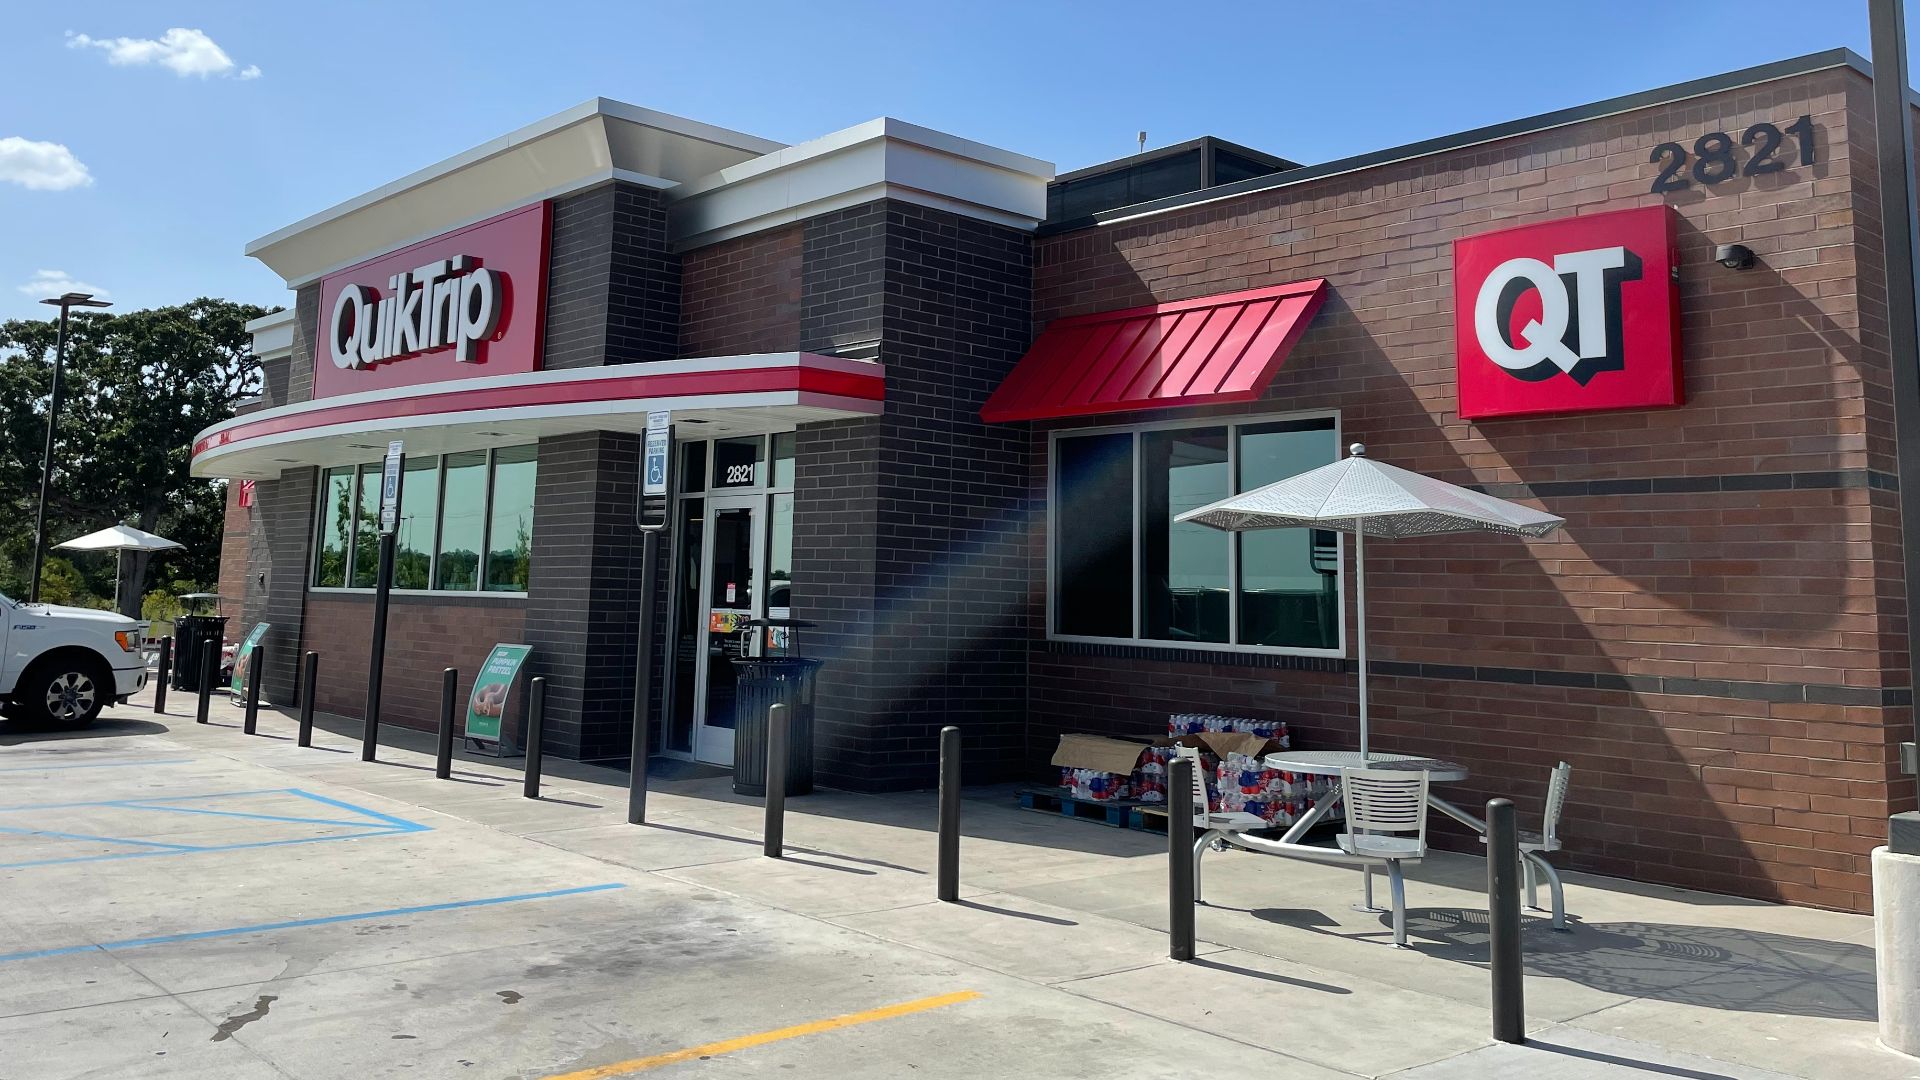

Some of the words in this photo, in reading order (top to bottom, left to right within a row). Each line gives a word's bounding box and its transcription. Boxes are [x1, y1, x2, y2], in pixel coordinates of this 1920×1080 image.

[1650, 115, 1815, 193] 2821
[330, 254, 499, 370] QuikTrip
[1474, 245, 1626, 375] QT
[726, 463, 754, 484] 2821
